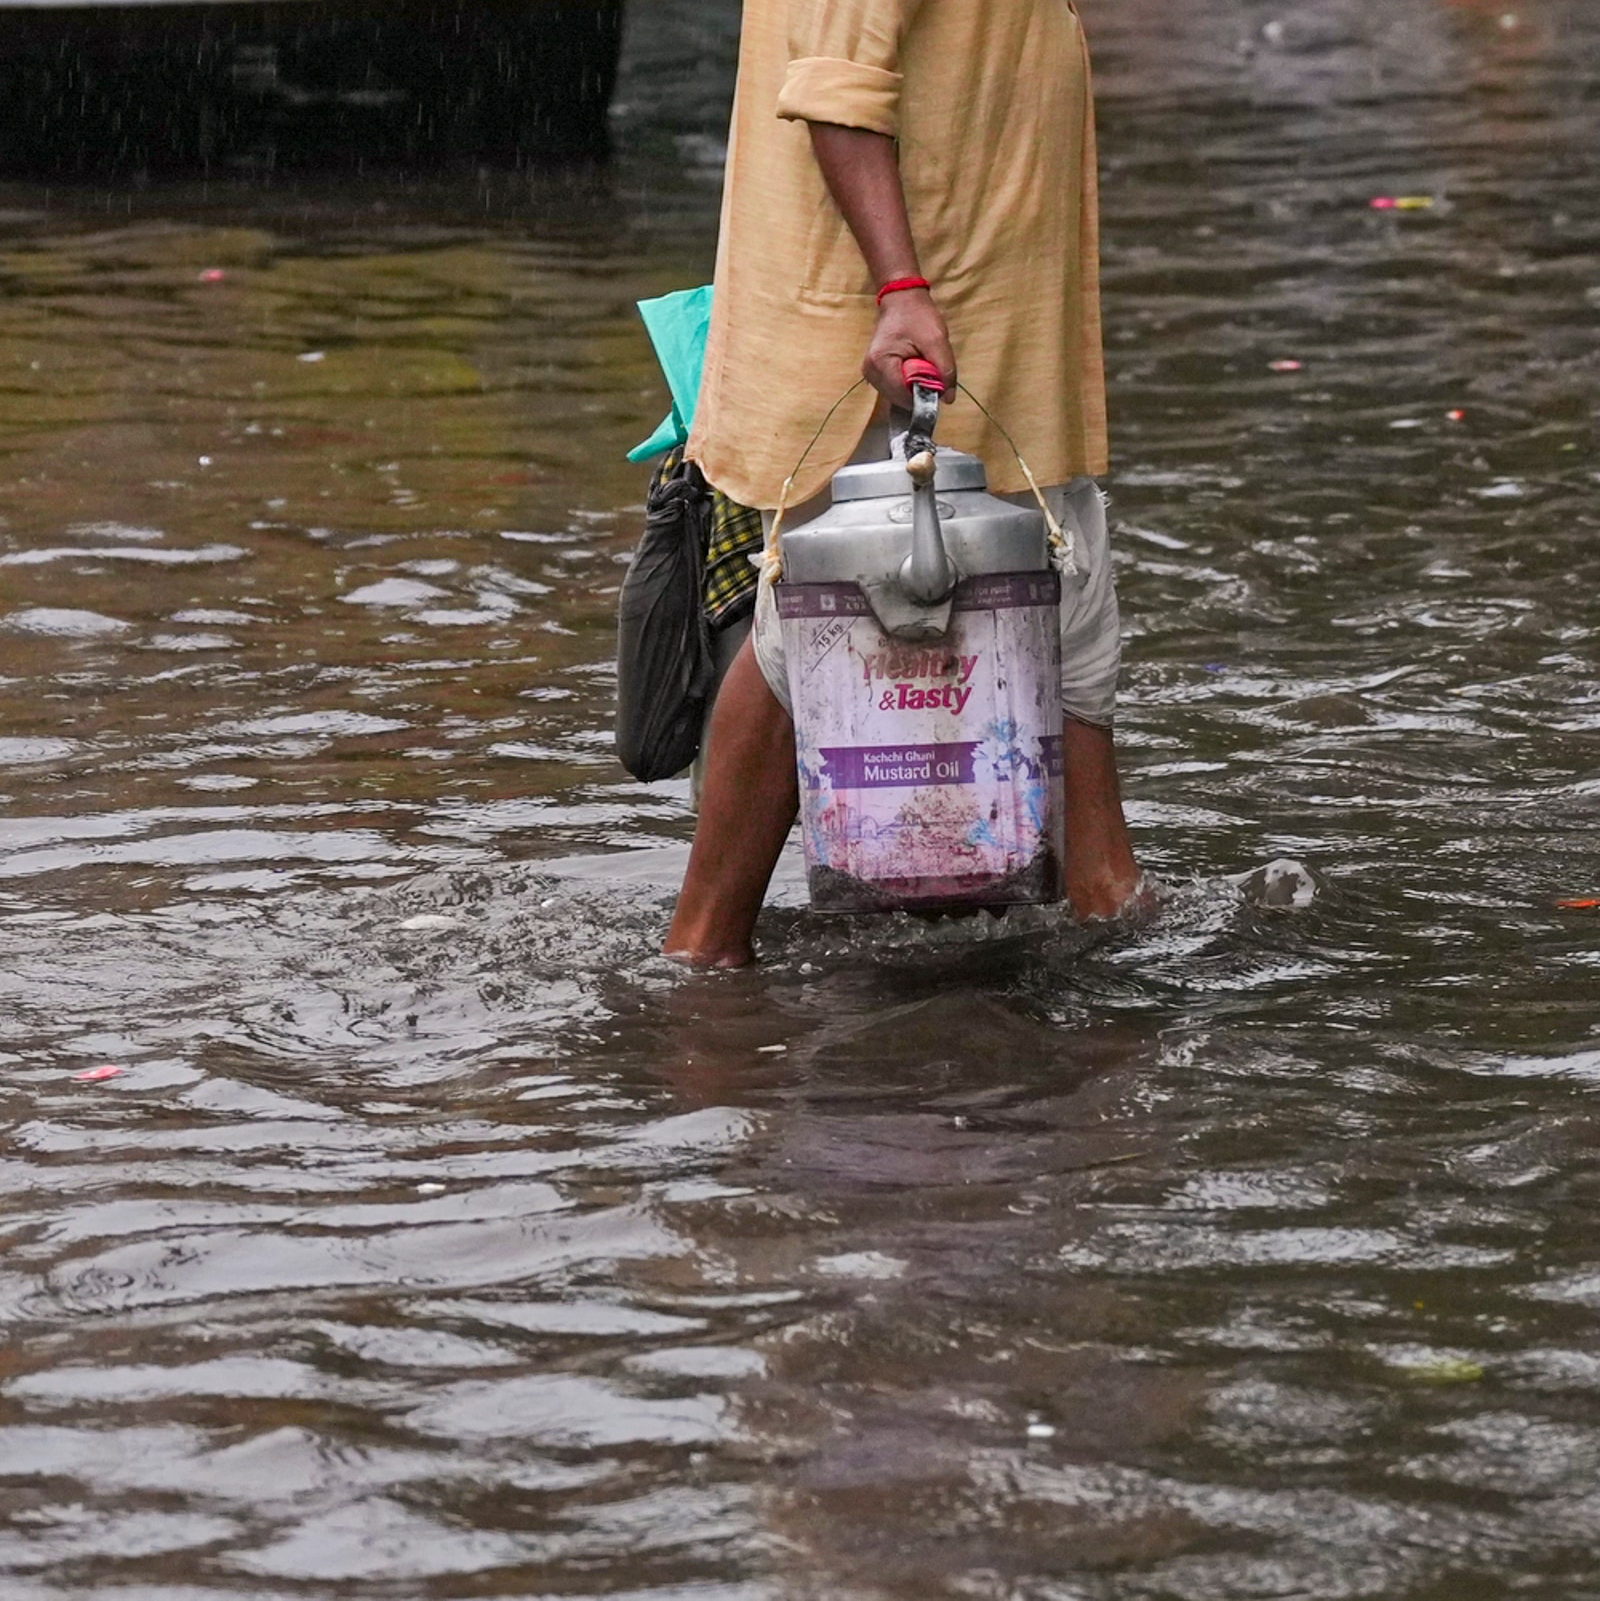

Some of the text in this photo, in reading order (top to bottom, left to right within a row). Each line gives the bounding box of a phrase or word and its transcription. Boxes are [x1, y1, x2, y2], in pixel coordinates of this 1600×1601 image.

[816, 633, 830, 649] 15
[864, 761, 960, 782] Mustard Oil
